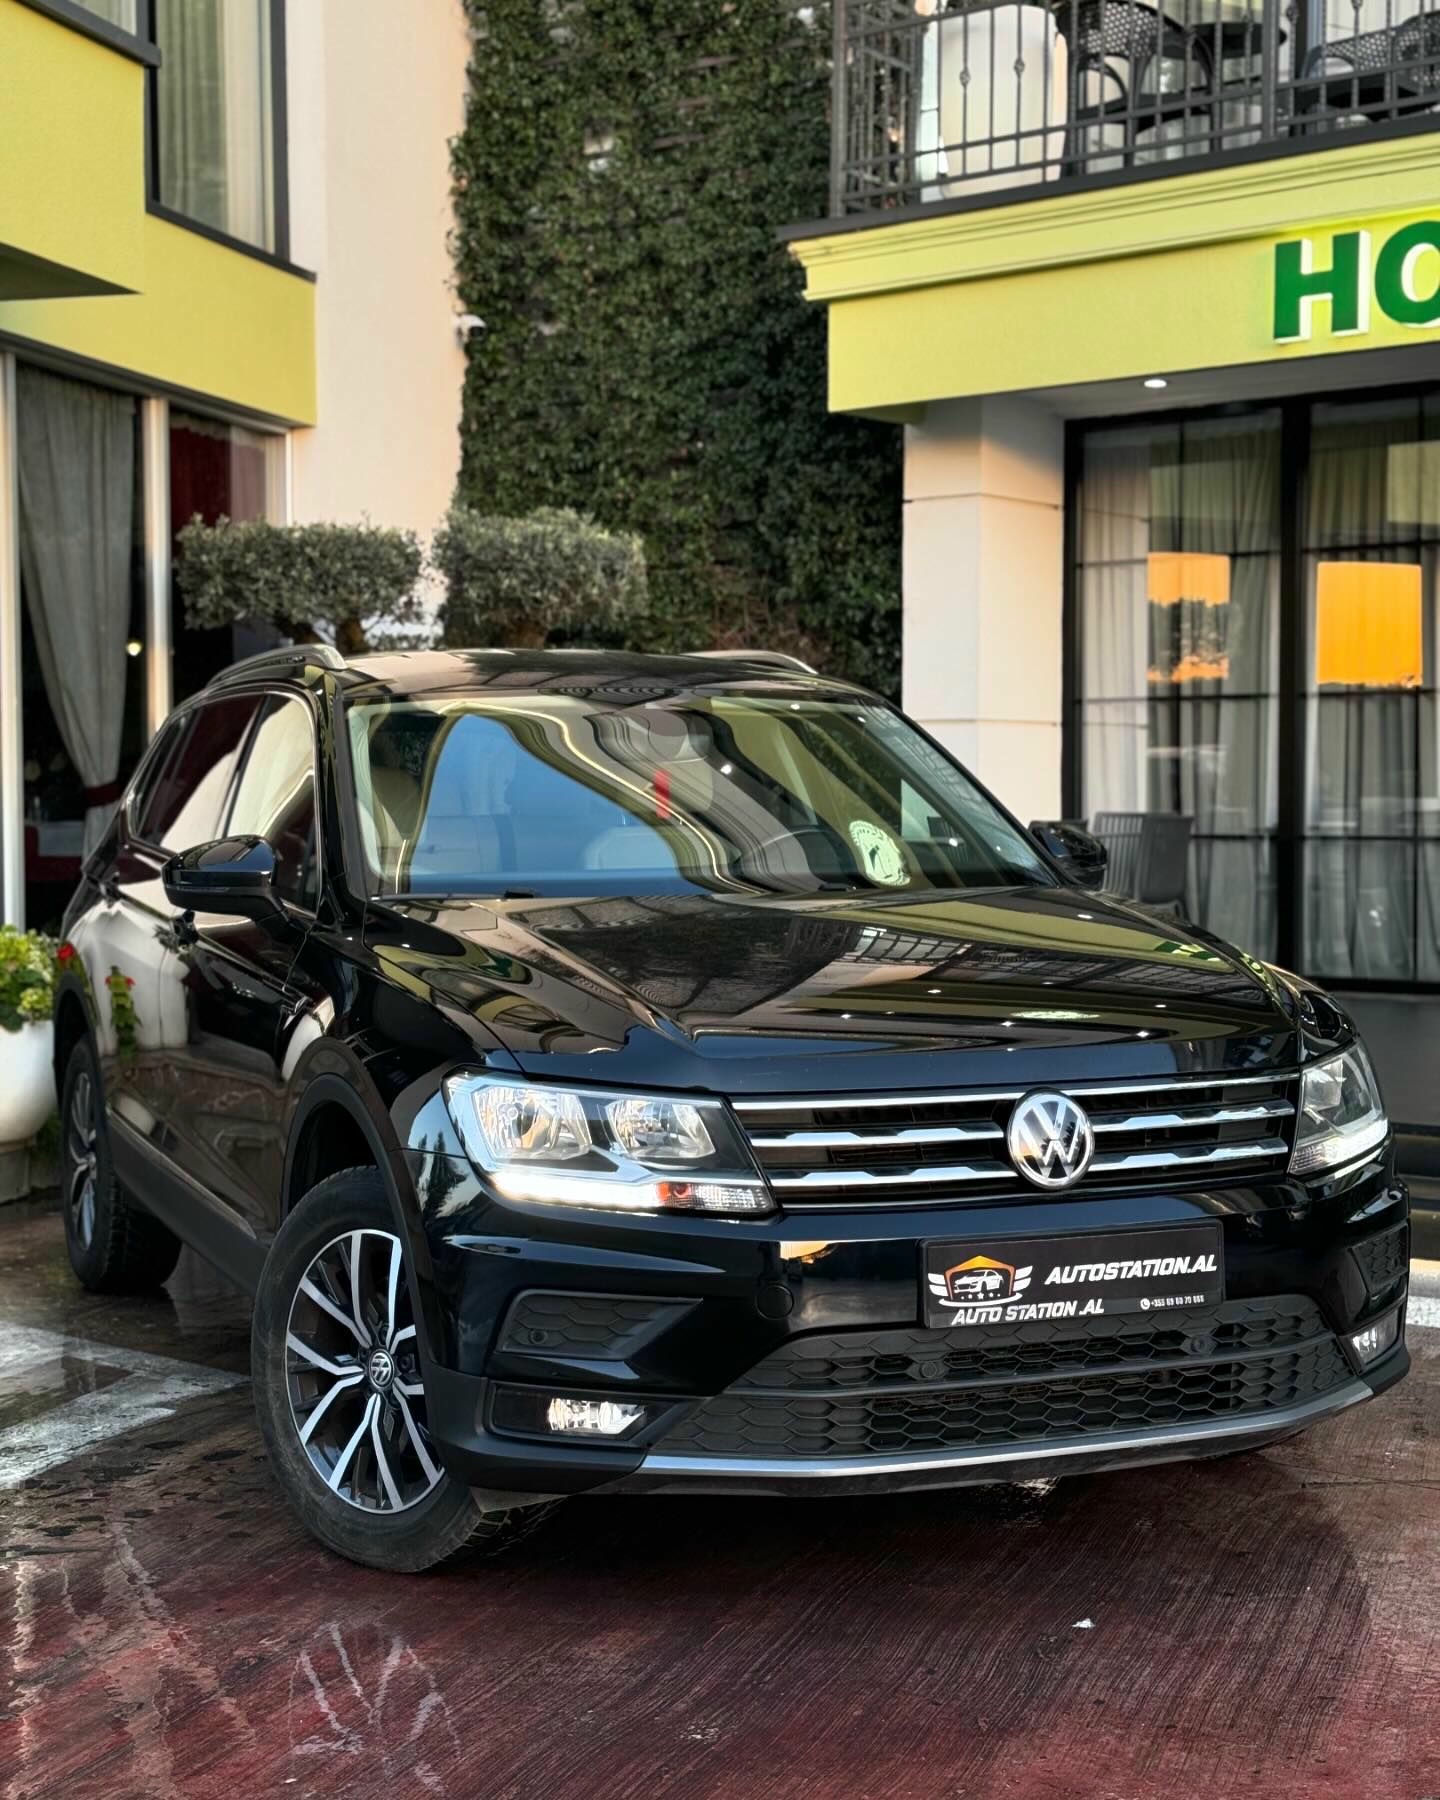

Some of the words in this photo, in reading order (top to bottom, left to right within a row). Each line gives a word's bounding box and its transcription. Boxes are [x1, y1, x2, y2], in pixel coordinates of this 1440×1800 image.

[1273, 220, 1440, 342] HO
[1044, 1254, 1218, 1286] AUTOSTATION.AL
[951, 1304, 1003, 1326] AUTO
[1005, 1301, 1077, 1321] STATION
[1079, 1298, 1105, 1315] .AL
